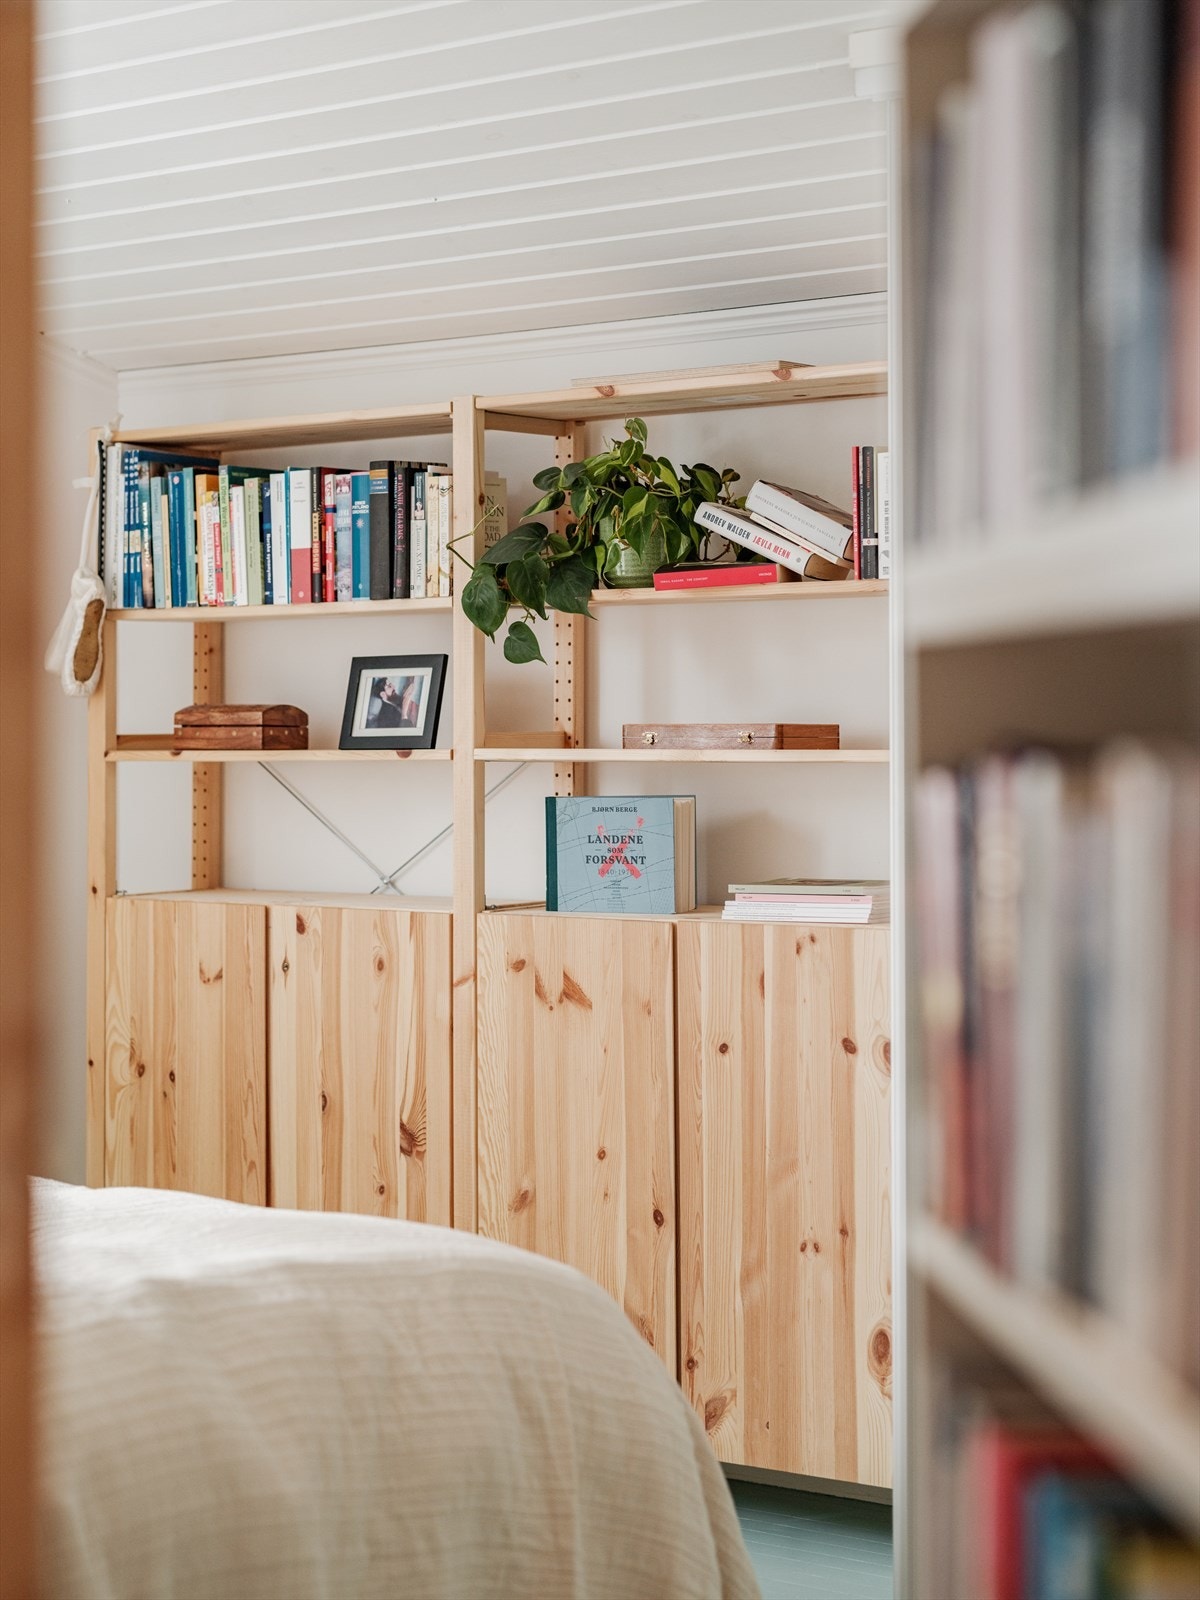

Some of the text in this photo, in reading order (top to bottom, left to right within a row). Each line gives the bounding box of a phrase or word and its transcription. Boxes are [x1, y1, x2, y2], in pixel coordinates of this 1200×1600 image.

[206, 505, 214, 553] COMPLETE
[702, 511, 791, 560] ANDREV WALDEN JÆVLA MENN
[587, 834, 644, 845] LANDENE
[585, 855, 647, 865] FORSVANT
